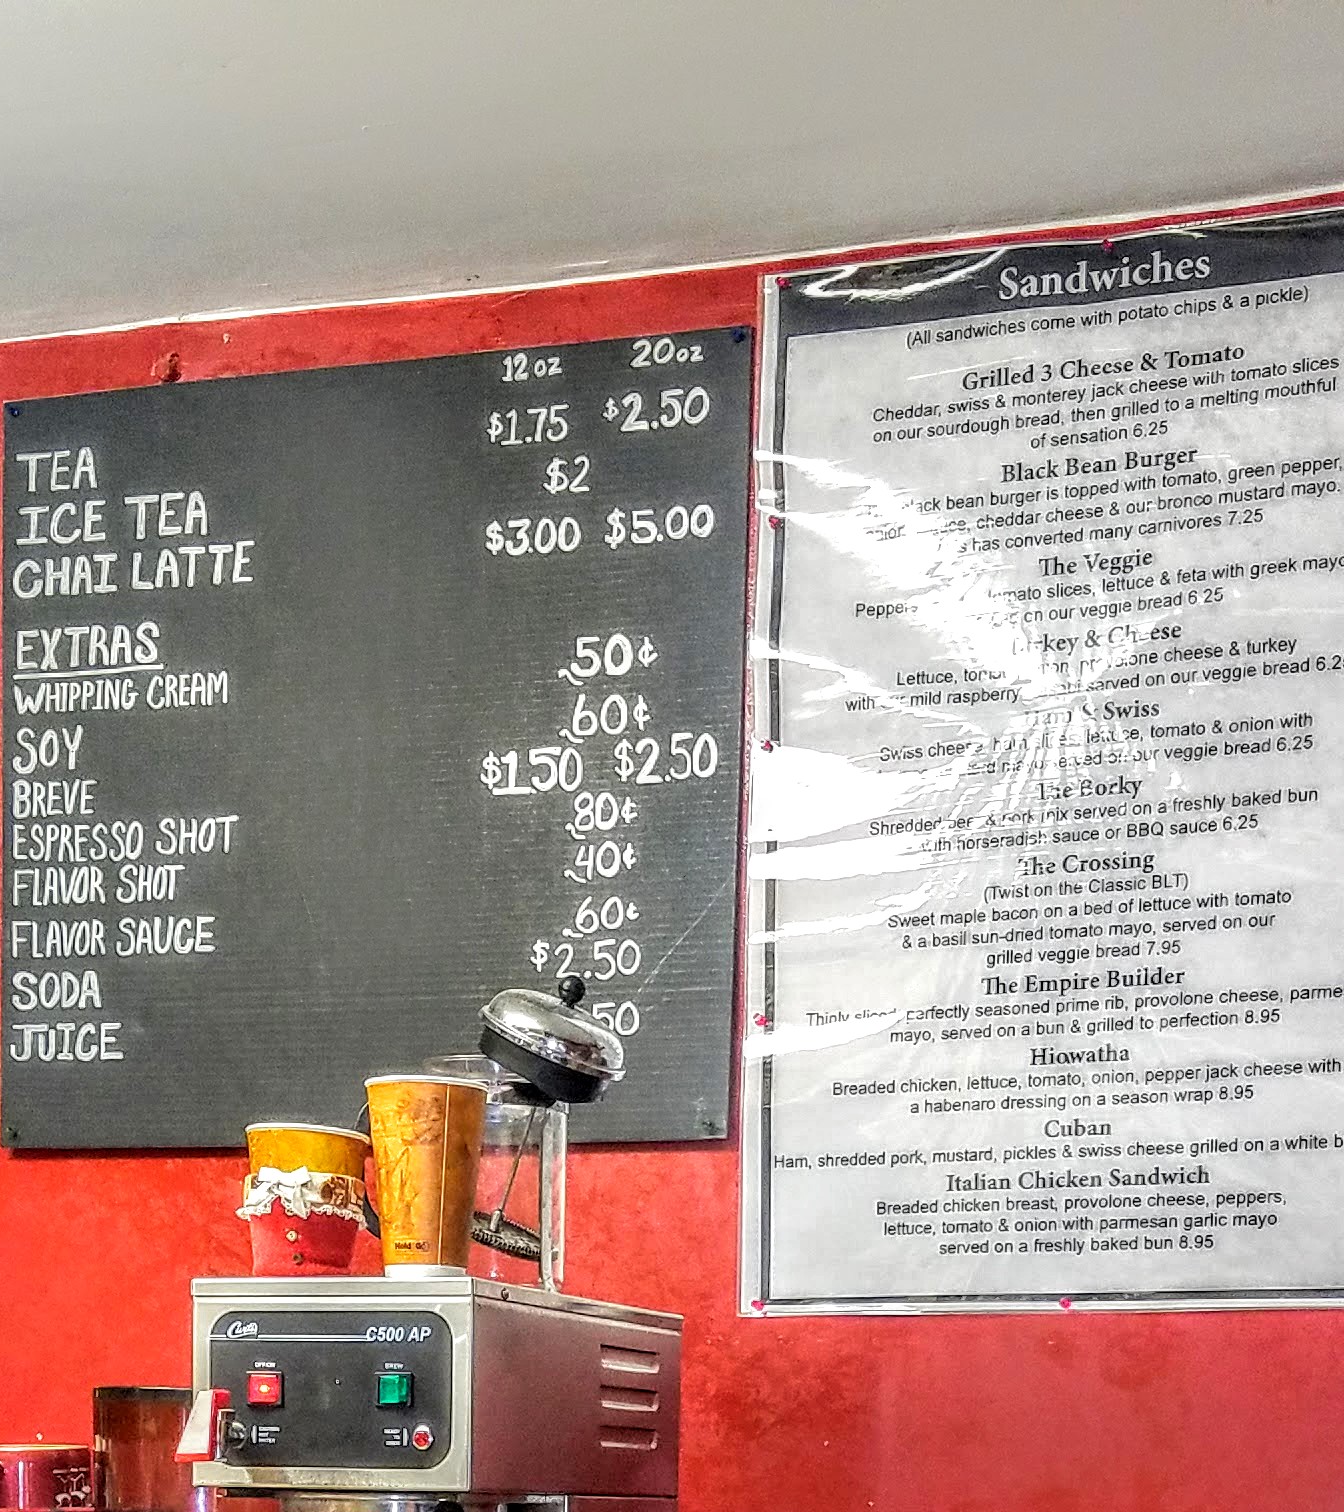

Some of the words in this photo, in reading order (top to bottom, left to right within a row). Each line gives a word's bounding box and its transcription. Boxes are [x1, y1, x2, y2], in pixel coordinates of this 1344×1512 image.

[999, 251, 1210, 299] Sandwiches
[963, 364, 1034, 390] Grilled
[1041, 365, 1052, 381] 3
[1059, 359, 1133, 379] Cheese
[1141, 353, 1158, 371] &
[1164, 346, 1244, 369] Tomato
[16, 447, 97, 492] TEA
[487, 404, 569, 445] $1.75
[603, 386, 709, 431] $2.50
[1001, 459, 1059, 483] Black
[1065, 458, 1116, 476] Bean
[1124, 449, 1198, 471] Burger
[16, 500, 106, 545] ICE
[124, 491, 207, 539] TEA
[543, 455, 589, 494] $2
[13, 553, 117, 599] CHAI
[132, 540, 255, 589] LATTE
[486, 517, 581, 555] $3.00
[605, 505, 715, 549] $5.00
[1039, 556, 1077, 577] The
[1083, 549, 1153, 575] Veggie
[17, 621, 159, 670] EXTRAS
[14, 679, 139, 714] WHIPPING
[147, 671, 227, 709] CREAM
[13, 725, 83, 774] SOY
[614, 733, 718, 784] $2.50
[13, 821, 143, 861] ESPRESSO
[156, 815, 239, 855] SHOT
[13, 866, 105, 906] FLAVOR
[116, 864, 185, 903] SHOT
[12, 971, 101, 1010] SODA
[530, 939, 641, 980] $2.50
[981, 976, 1017, 995] The
[1024, 975, 1099, 997] Empire
[1106, 967, 1185, 987] Builder
[10, 1023, 124, 1061] JUICE
[1044, 1118, 1111, 1137] Cuban
[775, 1155, 811, 1169] Ham,
[818, 1151, 885, 1167] shredded
[891, 1150, 927, 1168] pork,
[932, 1146, 998, 1168] mustard,
[1003, 1146, 1056, 1164] pickles
[1062, 1145, 1073, 1158] &
[1078, 1146, 1121, 1157] swiss
[1127, 1142, 1184, 1156] cheese
[1190, 1138, 1238, 1157] grilled
[1244, 1140, 1263, 1151] on
[1270, 1140, 1279, 1151] a
[1285, 1135, 1328, 1150] white
[946, 1173, 1011, 1191] Italian
[1018, 1170, 1102, 1189] Chicken
[1109, 1165, 1210, 1186] Sandwich
[366, 1326, 404, 1342] C500
[407, 1326, 432, 1343] AP
